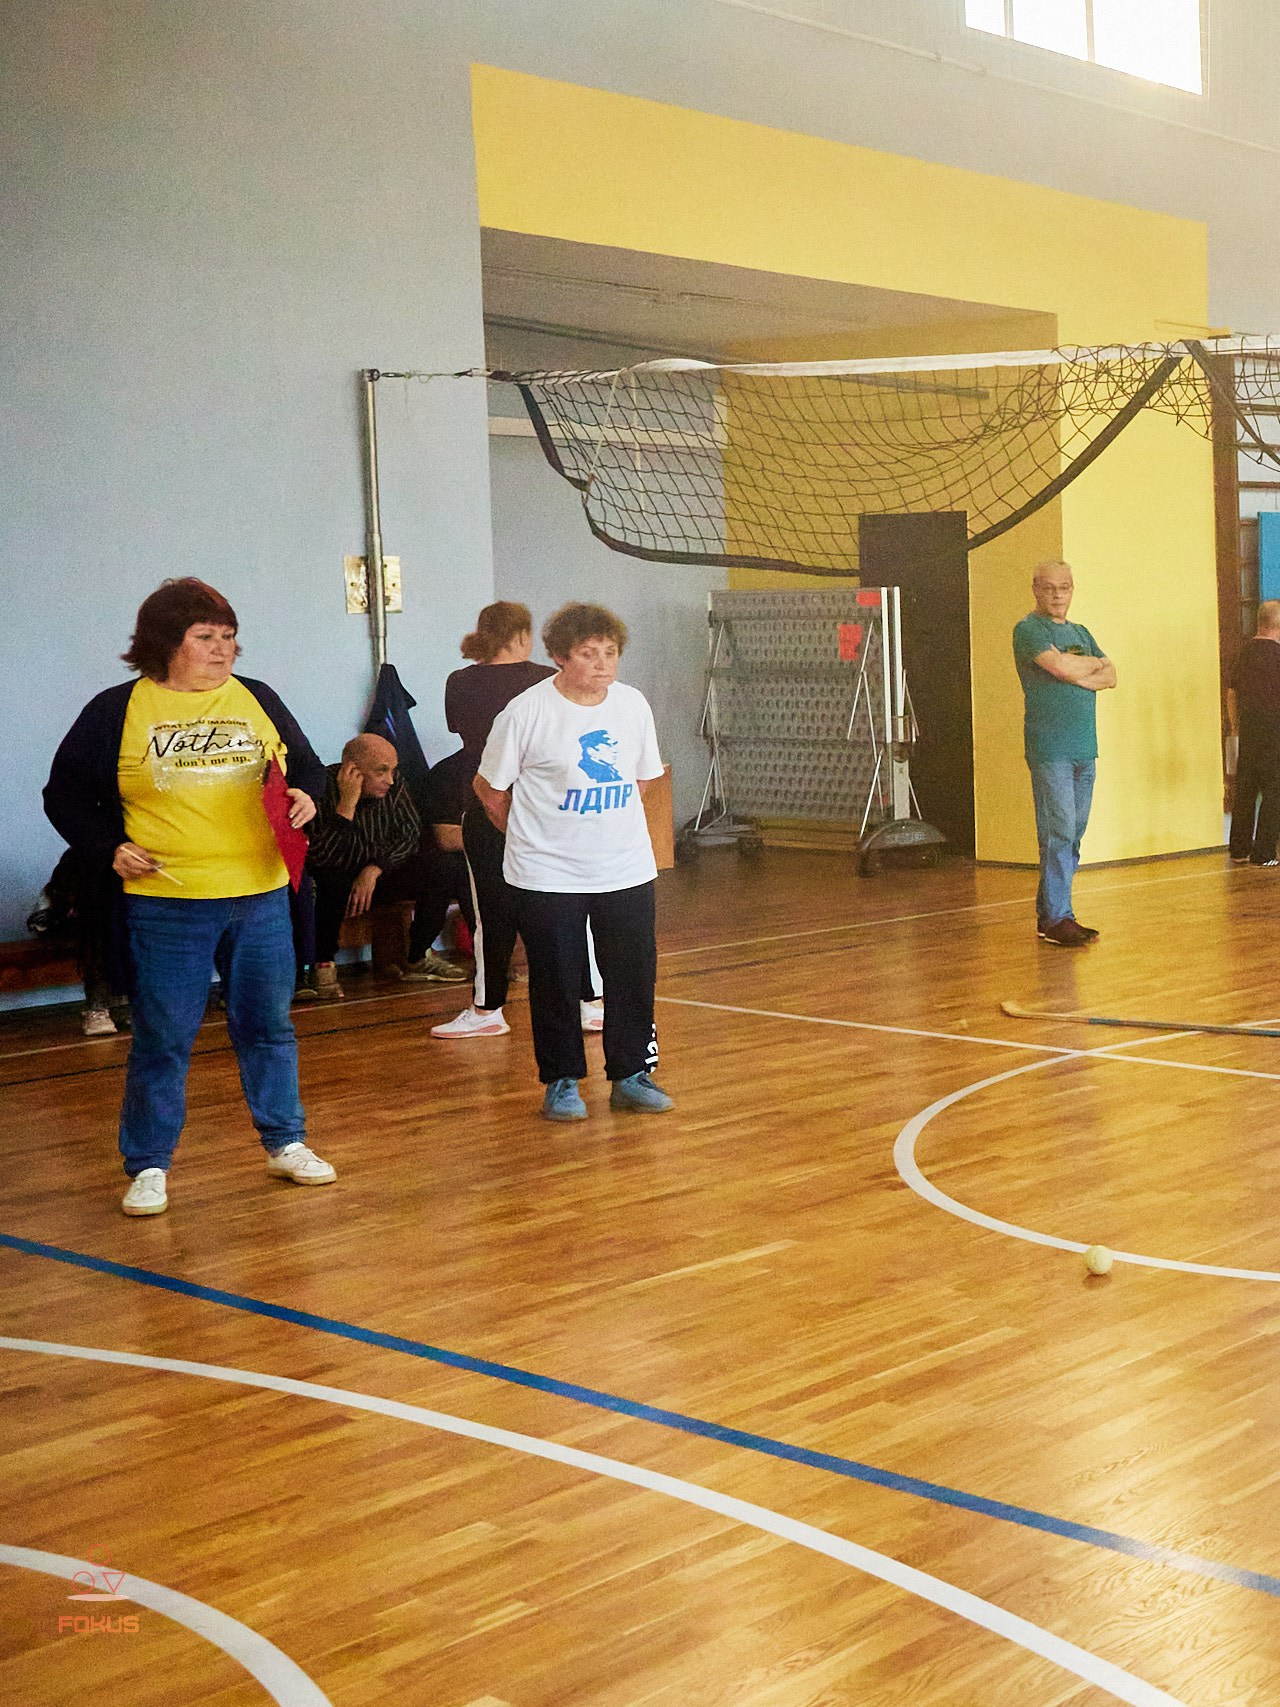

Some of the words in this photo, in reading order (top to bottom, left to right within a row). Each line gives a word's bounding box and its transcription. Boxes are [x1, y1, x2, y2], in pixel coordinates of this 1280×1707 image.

[141, 727, 268, 764] Nothing
[210, 756, 228, 765] me
[558, 783, 633, 815] ЛДПР
